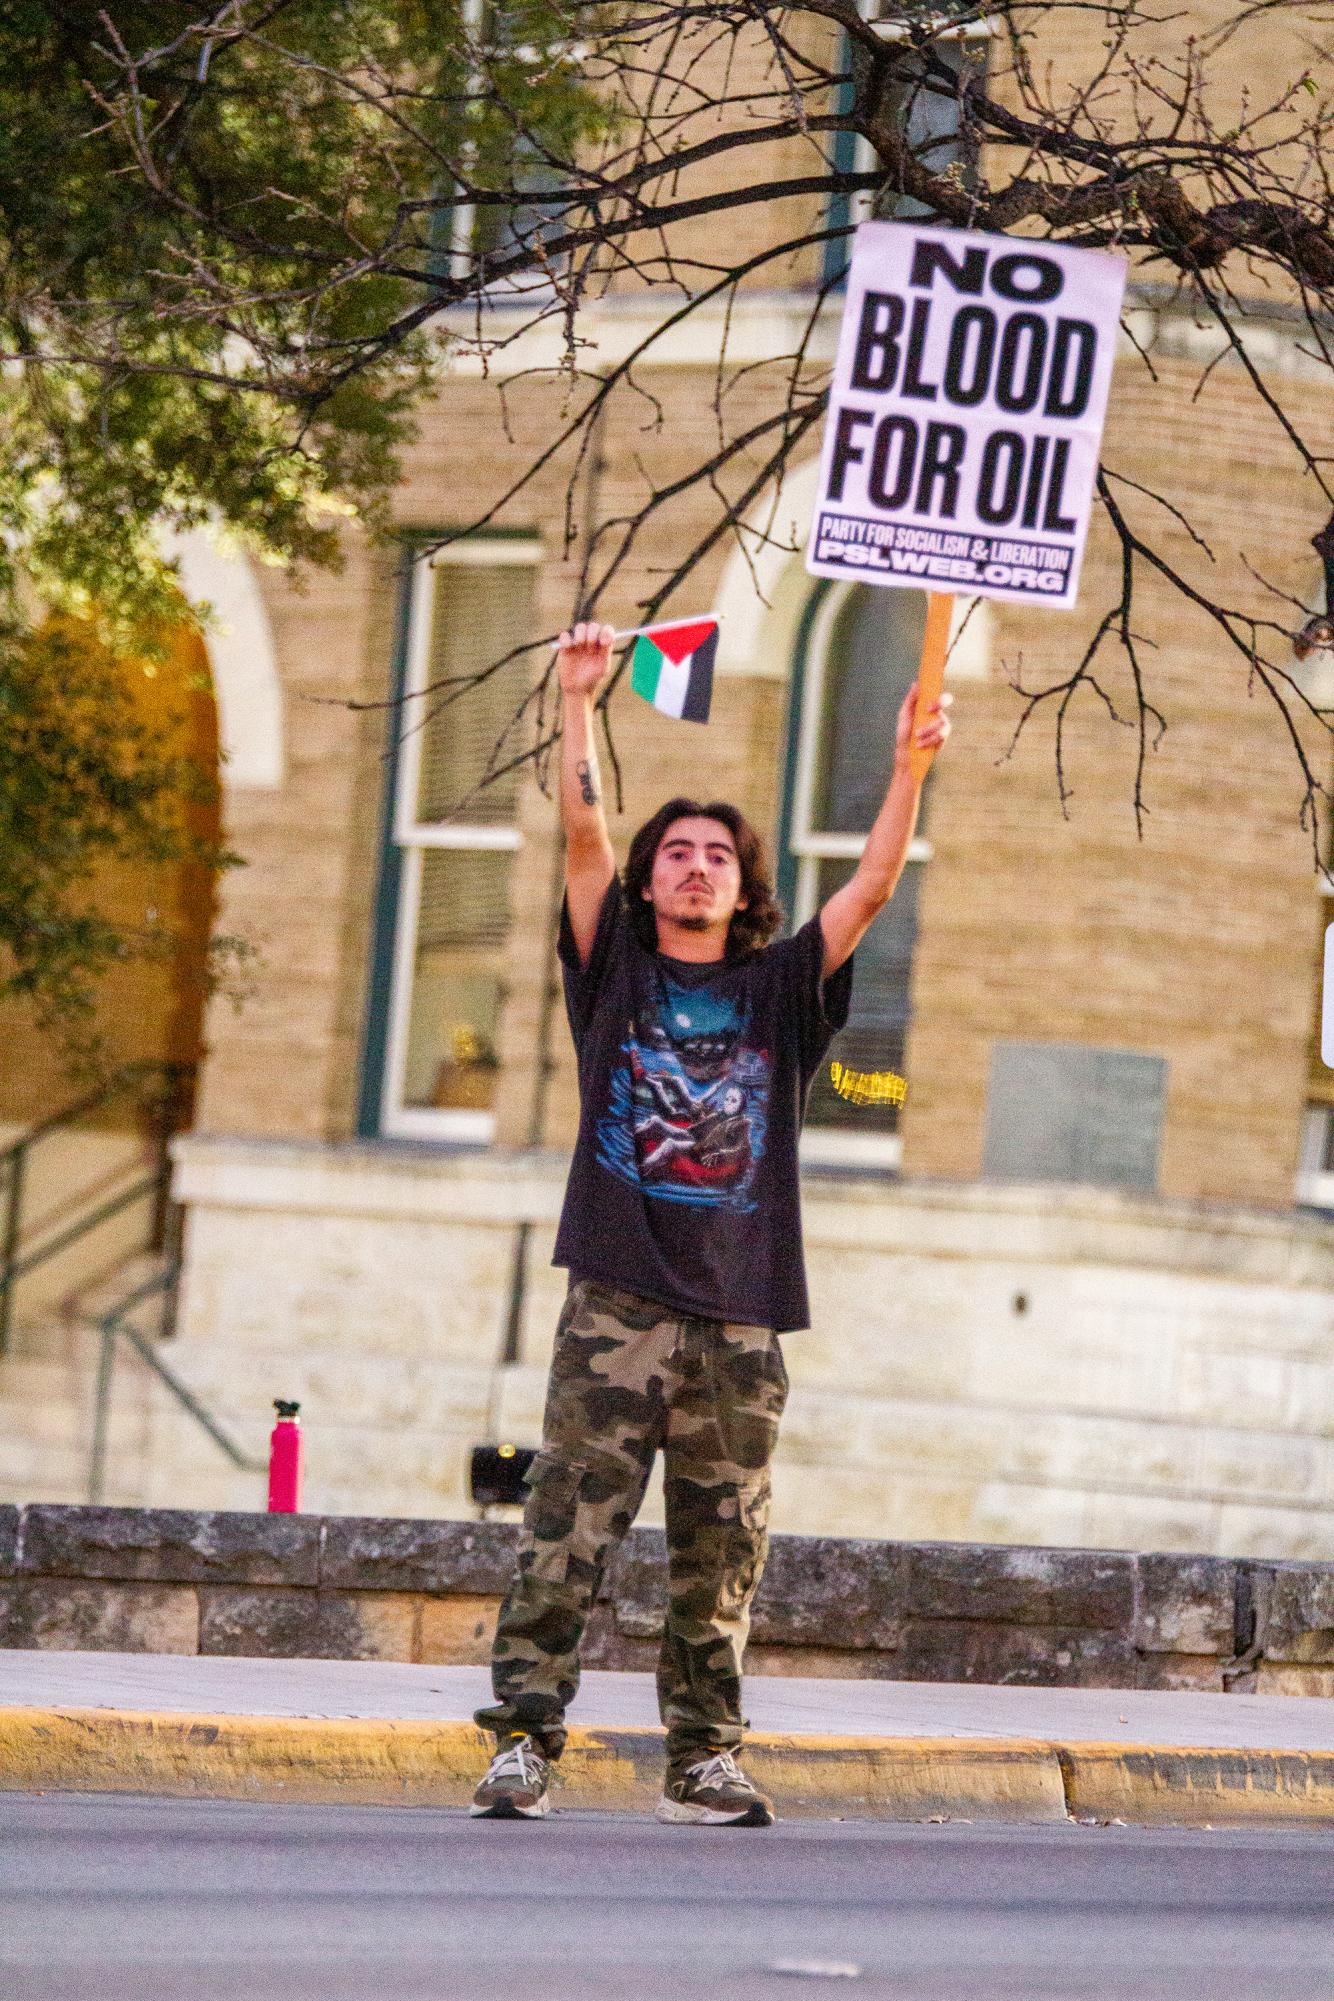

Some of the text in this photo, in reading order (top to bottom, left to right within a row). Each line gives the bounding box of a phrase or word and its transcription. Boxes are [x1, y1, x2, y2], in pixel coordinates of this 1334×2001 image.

[908, 238, 1065, 304] NO
[849, 289, 1098, 420] BLOOD
[825, 406, 1077, 535] FOR OIL
[818, 539, 1065, 592] PSLWEB.ORG
[821, 516, 1070, 570] PARTY FOR SOCIALISM & LIBERATION
